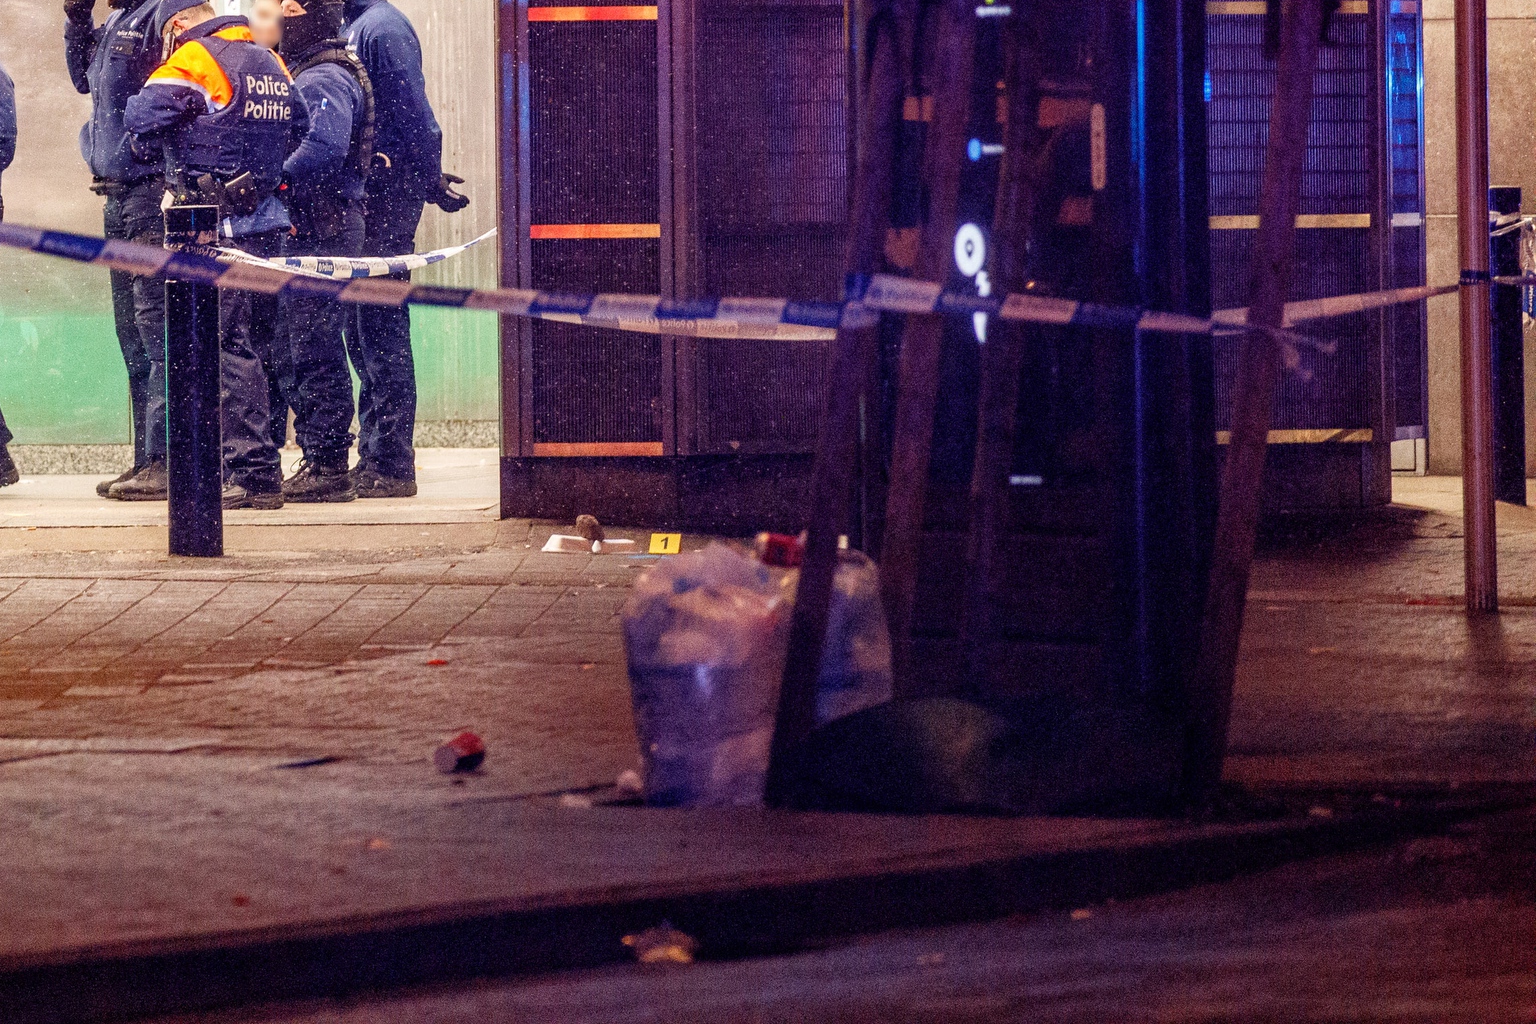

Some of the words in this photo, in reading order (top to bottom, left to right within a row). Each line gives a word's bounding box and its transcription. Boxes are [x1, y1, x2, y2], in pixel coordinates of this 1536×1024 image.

[246, 75, 290, 96] Police
[244, 99, 292, 121] Politie
[660, 536, 669, 550] 1
